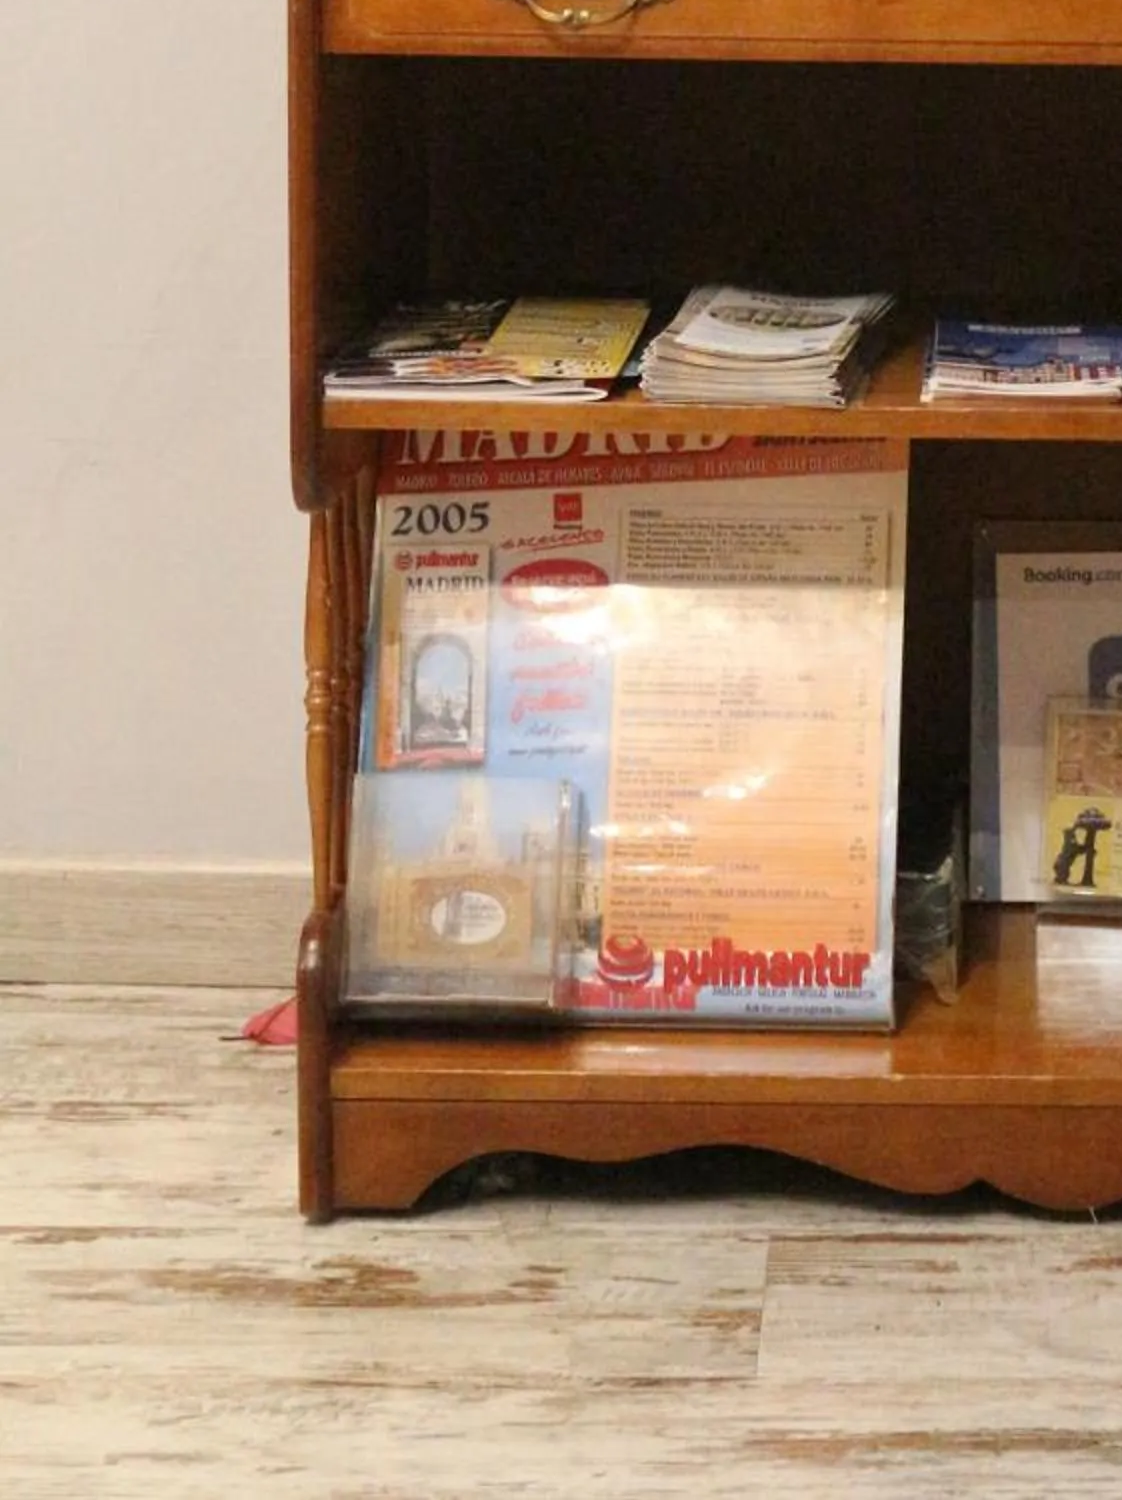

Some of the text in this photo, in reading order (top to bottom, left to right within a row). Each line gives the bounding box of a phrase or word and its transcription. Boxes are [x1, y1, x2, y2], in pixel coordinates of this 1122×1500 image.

[391, 501, 491, 536] 2005
[406, 576, 484, 593] MADRID
[664, 937, 870, 994] pullmantur
